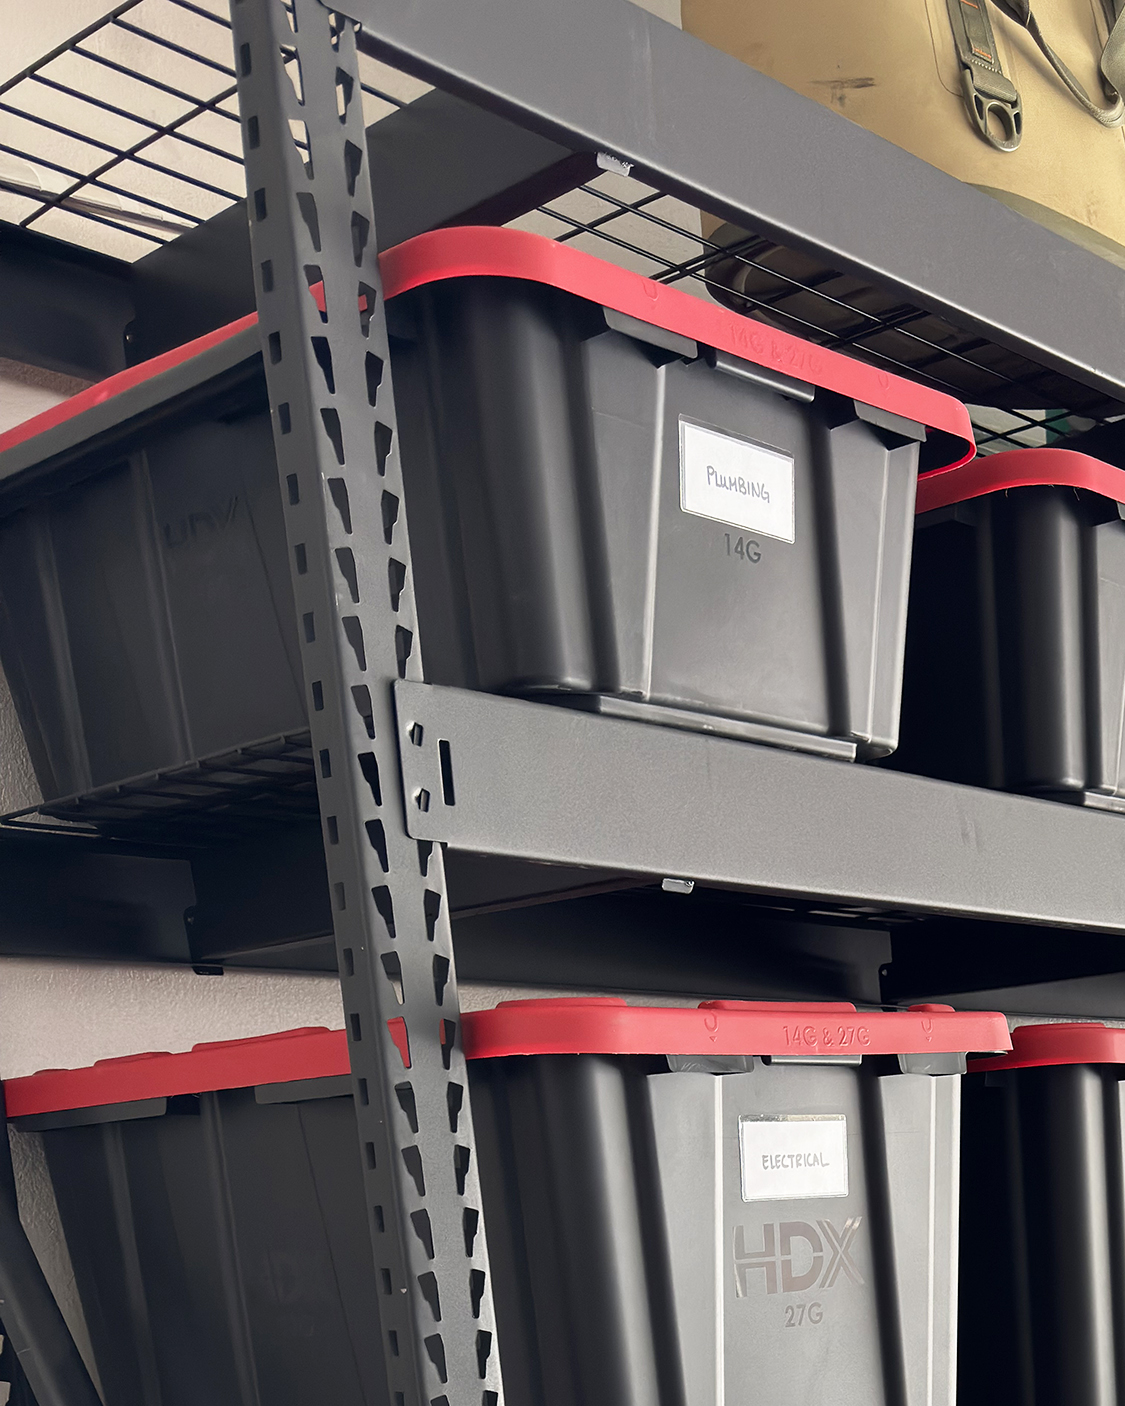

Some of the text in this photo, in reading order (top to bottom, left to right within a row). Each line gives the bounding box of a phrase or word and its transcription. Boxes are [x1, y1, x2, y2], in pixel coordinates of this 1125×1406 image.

[707, 465, 770, 503] PLUMBING
[724, 533, 762, 563] 14G
[782, 1025, 872, 1047] 14G & 27G
[762, 1153, 830, 1170] ELECTRICAL
[732, 1216, 866, 1298] HDX
[784, 1302, 824, 1328] 27G
